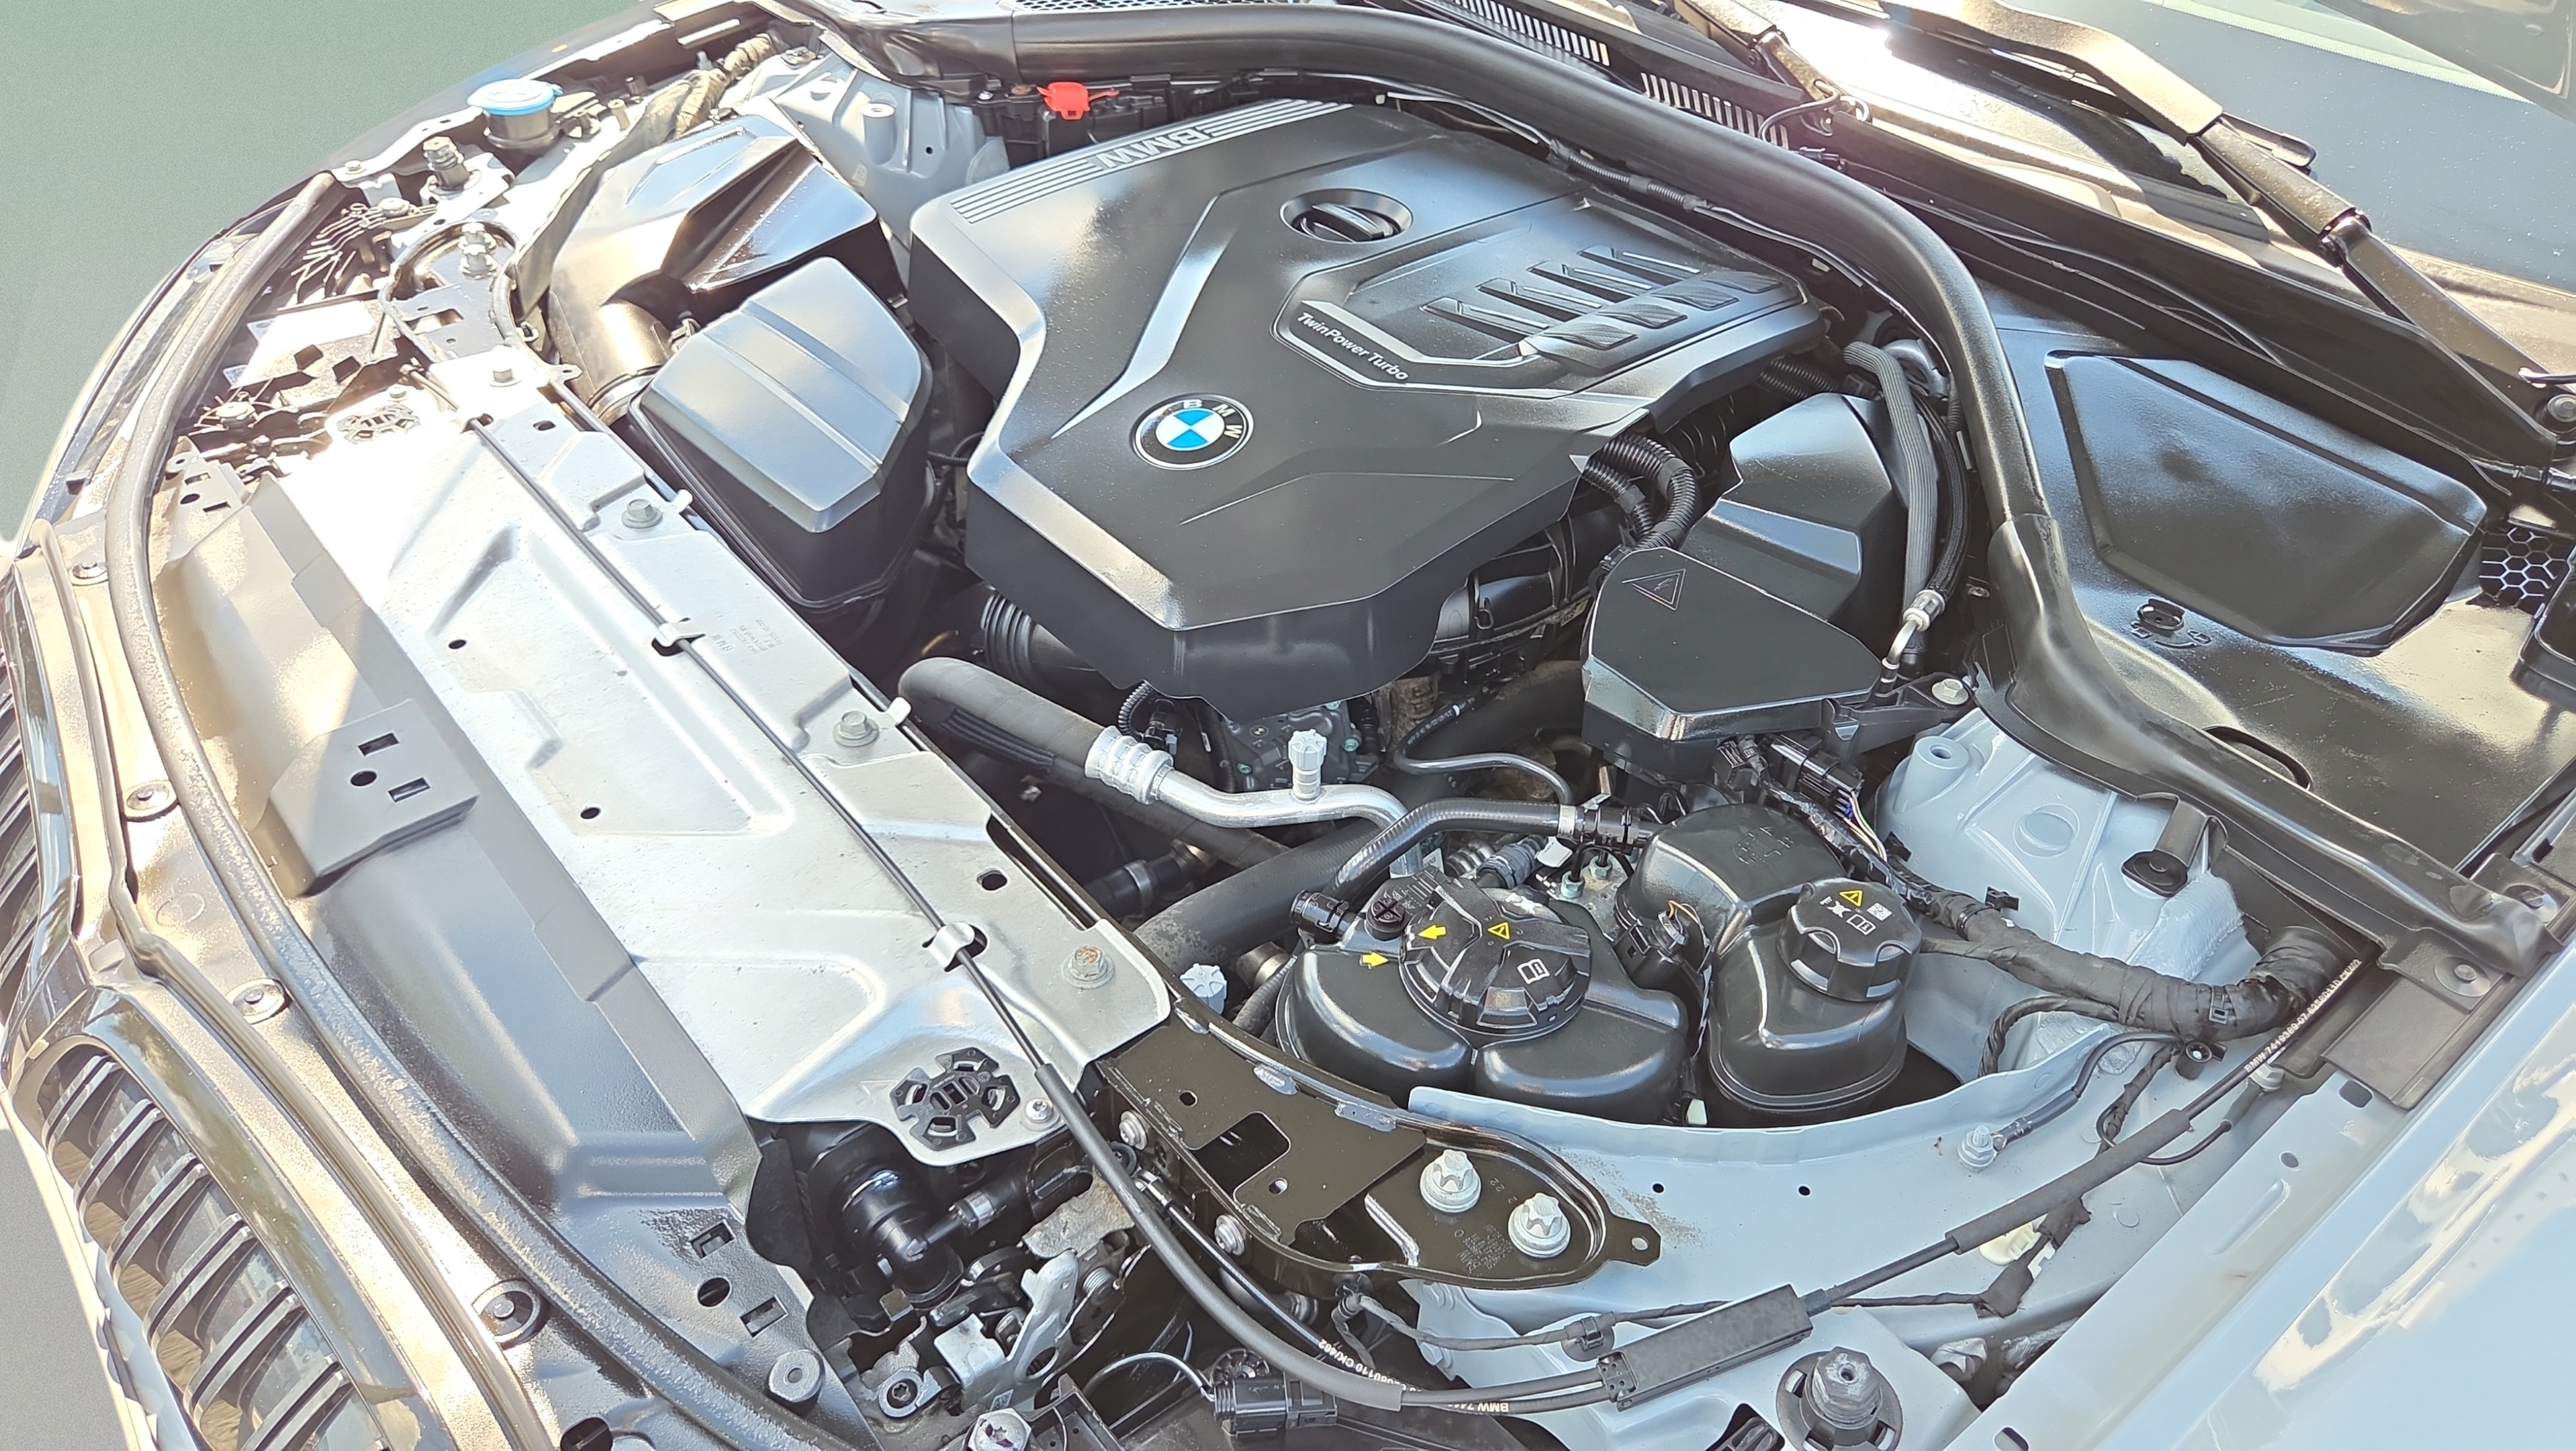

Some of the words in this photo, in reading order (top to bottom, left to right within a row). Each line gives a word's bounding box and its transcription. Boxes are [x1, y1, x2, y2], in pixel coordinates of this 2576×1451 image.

[1096, 128, 1211, 168] BMW
[1297, 312, 1370, 357] TwinPower
[1368, 353, 1409, 380] Turbo
[1183, 399, 1243, 439] BMW
[2244, 1052, 2266, 1073] BMW
[1477, 1402, 1509, 1413] BMW
